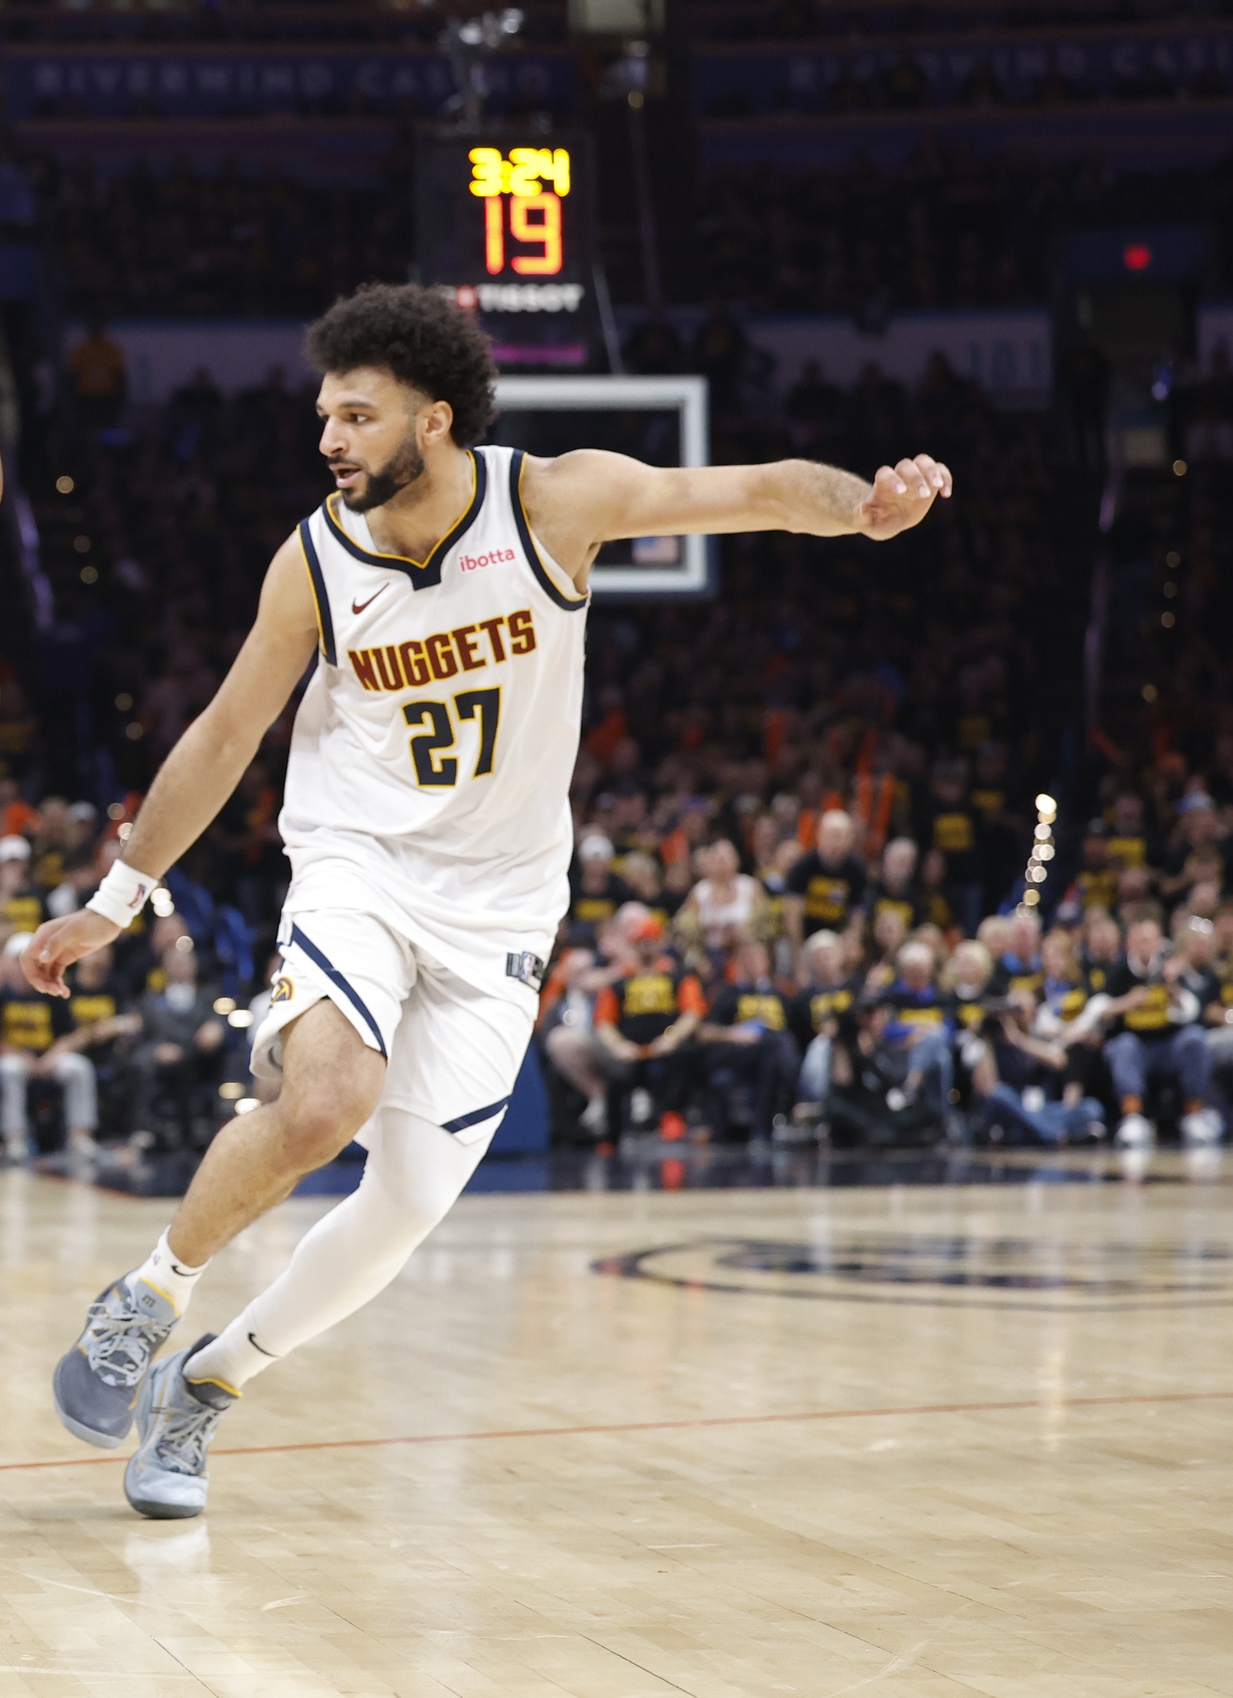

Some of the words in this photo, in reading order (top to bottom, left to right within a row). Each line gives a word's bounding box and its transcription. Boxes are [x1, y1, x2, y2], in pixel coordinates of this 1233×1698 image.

[356, 61, 550, 95] CASNO
[469, 147, 570, 197] 3:24
[484, 191, 563, 275] 19
[459, 549, 515, 572] ibotta
[348, 609, 536, 691] NUGGETS
[402, 685, 501, 788] 27
